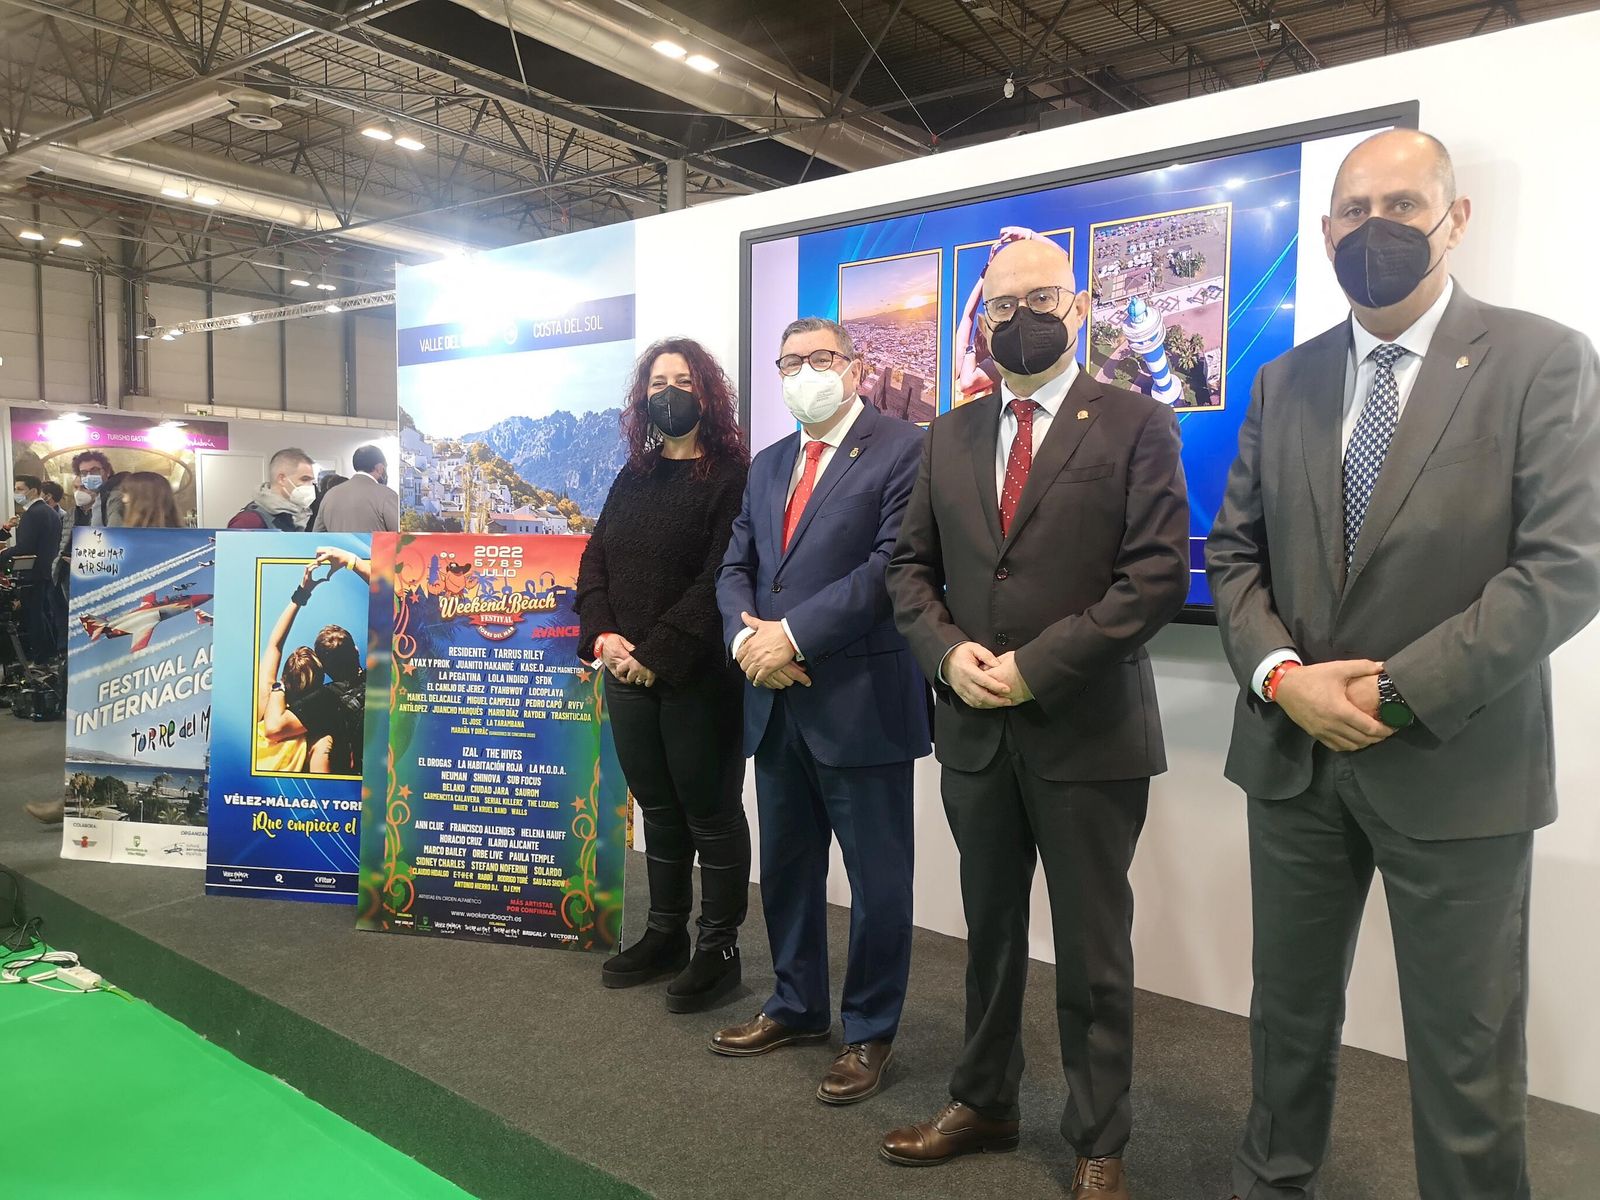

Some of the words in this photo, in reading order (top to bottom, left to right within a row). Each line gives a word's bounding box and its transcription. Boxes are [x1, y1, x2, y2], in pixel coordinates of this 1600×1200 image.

[534, 320, 562, 338] COSTA
[564, 318, 582, 334] DEL
[584, 315, 604, 331] SOL
[420, 336, 442, 352] VALLE
[474, 545, 523, 558] 2022
[474, 559, 483, 567] 6
[487, 559, 495, 567] 7
[500, 559, 509, 567] 8
[513, 559, 523, 568] 9
[480, 568, 516, 578] JULIO
[439, 594, 506, 618] Weekend
[506, 592, 556, 614] Beach
[480, 614, 514, 623] FESTIVAL
[478, 626, 496, 638] TORRE
[503, 626, 515, 636] MAR
[532, 626, 580, 639] AVANCE
[449, 647, 486, 658] RESIDENTE
[494, 649, 522, 659] TARRUS
[523, 650, 544, 660] RILEY
[410, 658, 426, 667] AYAX
[428, 659, 432, 668] Y
[434, 659, 450, 668] PROK
[456, 660, 483, 670] JUANITO
[484, 661, 514, 671] MAKANDÉ
[521, 663, 544, 673] KASE.O
[98, 655, 186, 702] FESTIVAL
[193, 644, 213, 668] A
[439, 672, 447, 680] LA
[449, 672, 481, 681] PEGATINA
[488, 674, 506, 682] LOLA
[507, 675, 528, 684] INDIGO
[535, 676, 552, 685] SFDK
[427, 683, 434, 691] EL
[435, 683, 456, 692] CANIJO
[458, 684, 465, 692] DE
[466, 685, 485, 693] JEREZ
[491, 686, 523, 695] FYAHBWOY
[529, 687, 563, 697] LOCOPLAYA
[407, 693, 427, 702] MAIKEL
[429, 694, 461, 704] DELACALLE
[467, 696, 488, 705] MIGUEL
[489, 697, 519, 706] CAMPELLO
[526, 699, 545, 708] PEDRO
[546, 699, 562, 708] CAPÓ
[568, 701, 584, 710] RVFV
[524, 710, 546, 719] RAYDEN
[551, 711, 591, 721] TRASHTUCADA
[179, 714, 195, 739] del
[201, 705, 211, 743] M
[494, 720, 524, 728] TARAMBANA
[463, 747, 478, 757] IZAL
[486, 748, 500, 758] THE
[501, 749, 522, 760] HIVES
[418, 757, 426, 766] EL
[427, 758, 452, 768] DROGAS
[458, 760, 466, 769] LA
[468, 760, 505, 771] HABITACIÓN
[506, 763, 523, 772] ROJA
[530, 764, 538, 773] LA
[540, 764, 567, 775] M.O.D.A.
[441, 771, 468, 781] NEUMAN
[473, 772, 500, 783] SHINOVA
[507, 775, 520, 784] SUB
[521, 776, 541, 786] FOCUS
[443, 783, 465, 792] BELAKO
[471, 785, 492, 794] CIUDAD
[493, 786, 509, 795] JARA
[515, 788, 539, 797] SAUROM
[224, 793, 318, 809] VÉLEZ-MÁLAGA
[321, 800, 330, 809] Y
[252, 811, 283, 838] ¡Que
[288, 819, 340, 837] empiece
[345, 818, 357, 835] el
[415, 820, 428, 830] ANN
[429, 821, 444, 831] CLUE
[450, 823, 483, 833] FRANCISCO
[484, 825, 515, 836] ALLENDES
[521, 828, 545, 838] HELENA
[546, 830, 566, 840] HAUFF
[440, 834, 465, 844] HORACIO
[467, 836, 483, 846] CRUZ
[488, 838, 508, 848] ILARIO
[509, 840, 540, 850] ALICANTE
[424, 845, 444, 854] MARCO
[445, 847, 467, 857] BAILEY
[473, 849, 488, 858] ORBE
[489, 850, 504, 860] LIVE
[416, 857, 437, 866] SIDNEY
[438, 858, 466, 868] CHARLES
[509, 852, 529, 862] PAULA
[531, 853, 555, 864] TEMPLE
[471, 861, 498, 871] STEFANO
[500, 863, 528, 874] NOFERINI
[534, 866, 562, 877] SOLARDO
[525, 901, 553, 909] ARTISTAS
[451, 911, 522, 922] www.weekendbeach.es
[521, 907, 557, 916] CONFIRMAR
